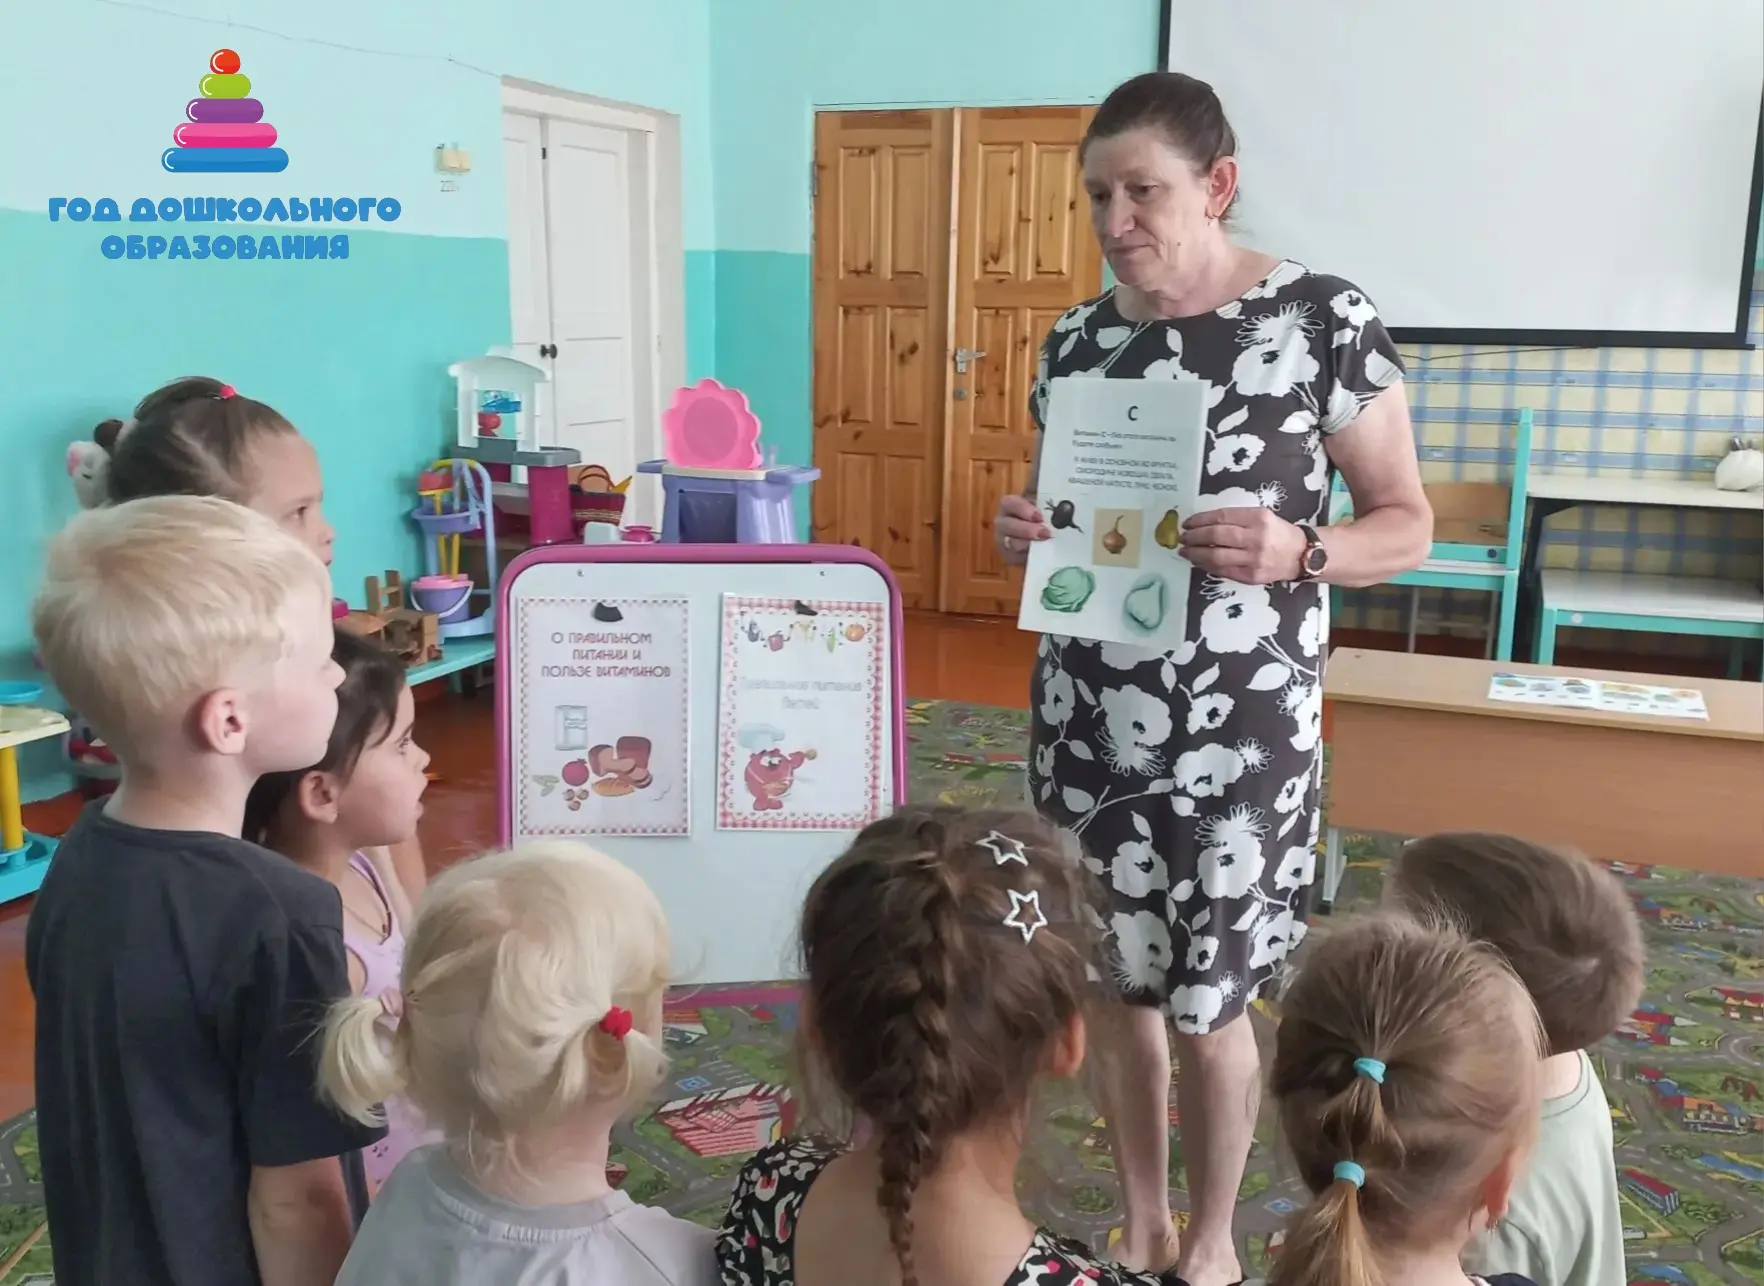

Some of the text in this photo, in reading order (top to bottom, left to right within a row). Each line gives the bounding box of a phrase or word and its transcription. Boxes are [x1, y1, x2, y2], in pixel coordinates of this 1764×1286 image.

[1127, 405, 1139, 421] С
[550, 631, 653, 645] О ПРАВИЛЬНОМ
[572, 648, 642, 661] ПИТАНИИ И
[541, 665, 672, 678] ПОЛЬЗЕ ВИТАМИНОВ
